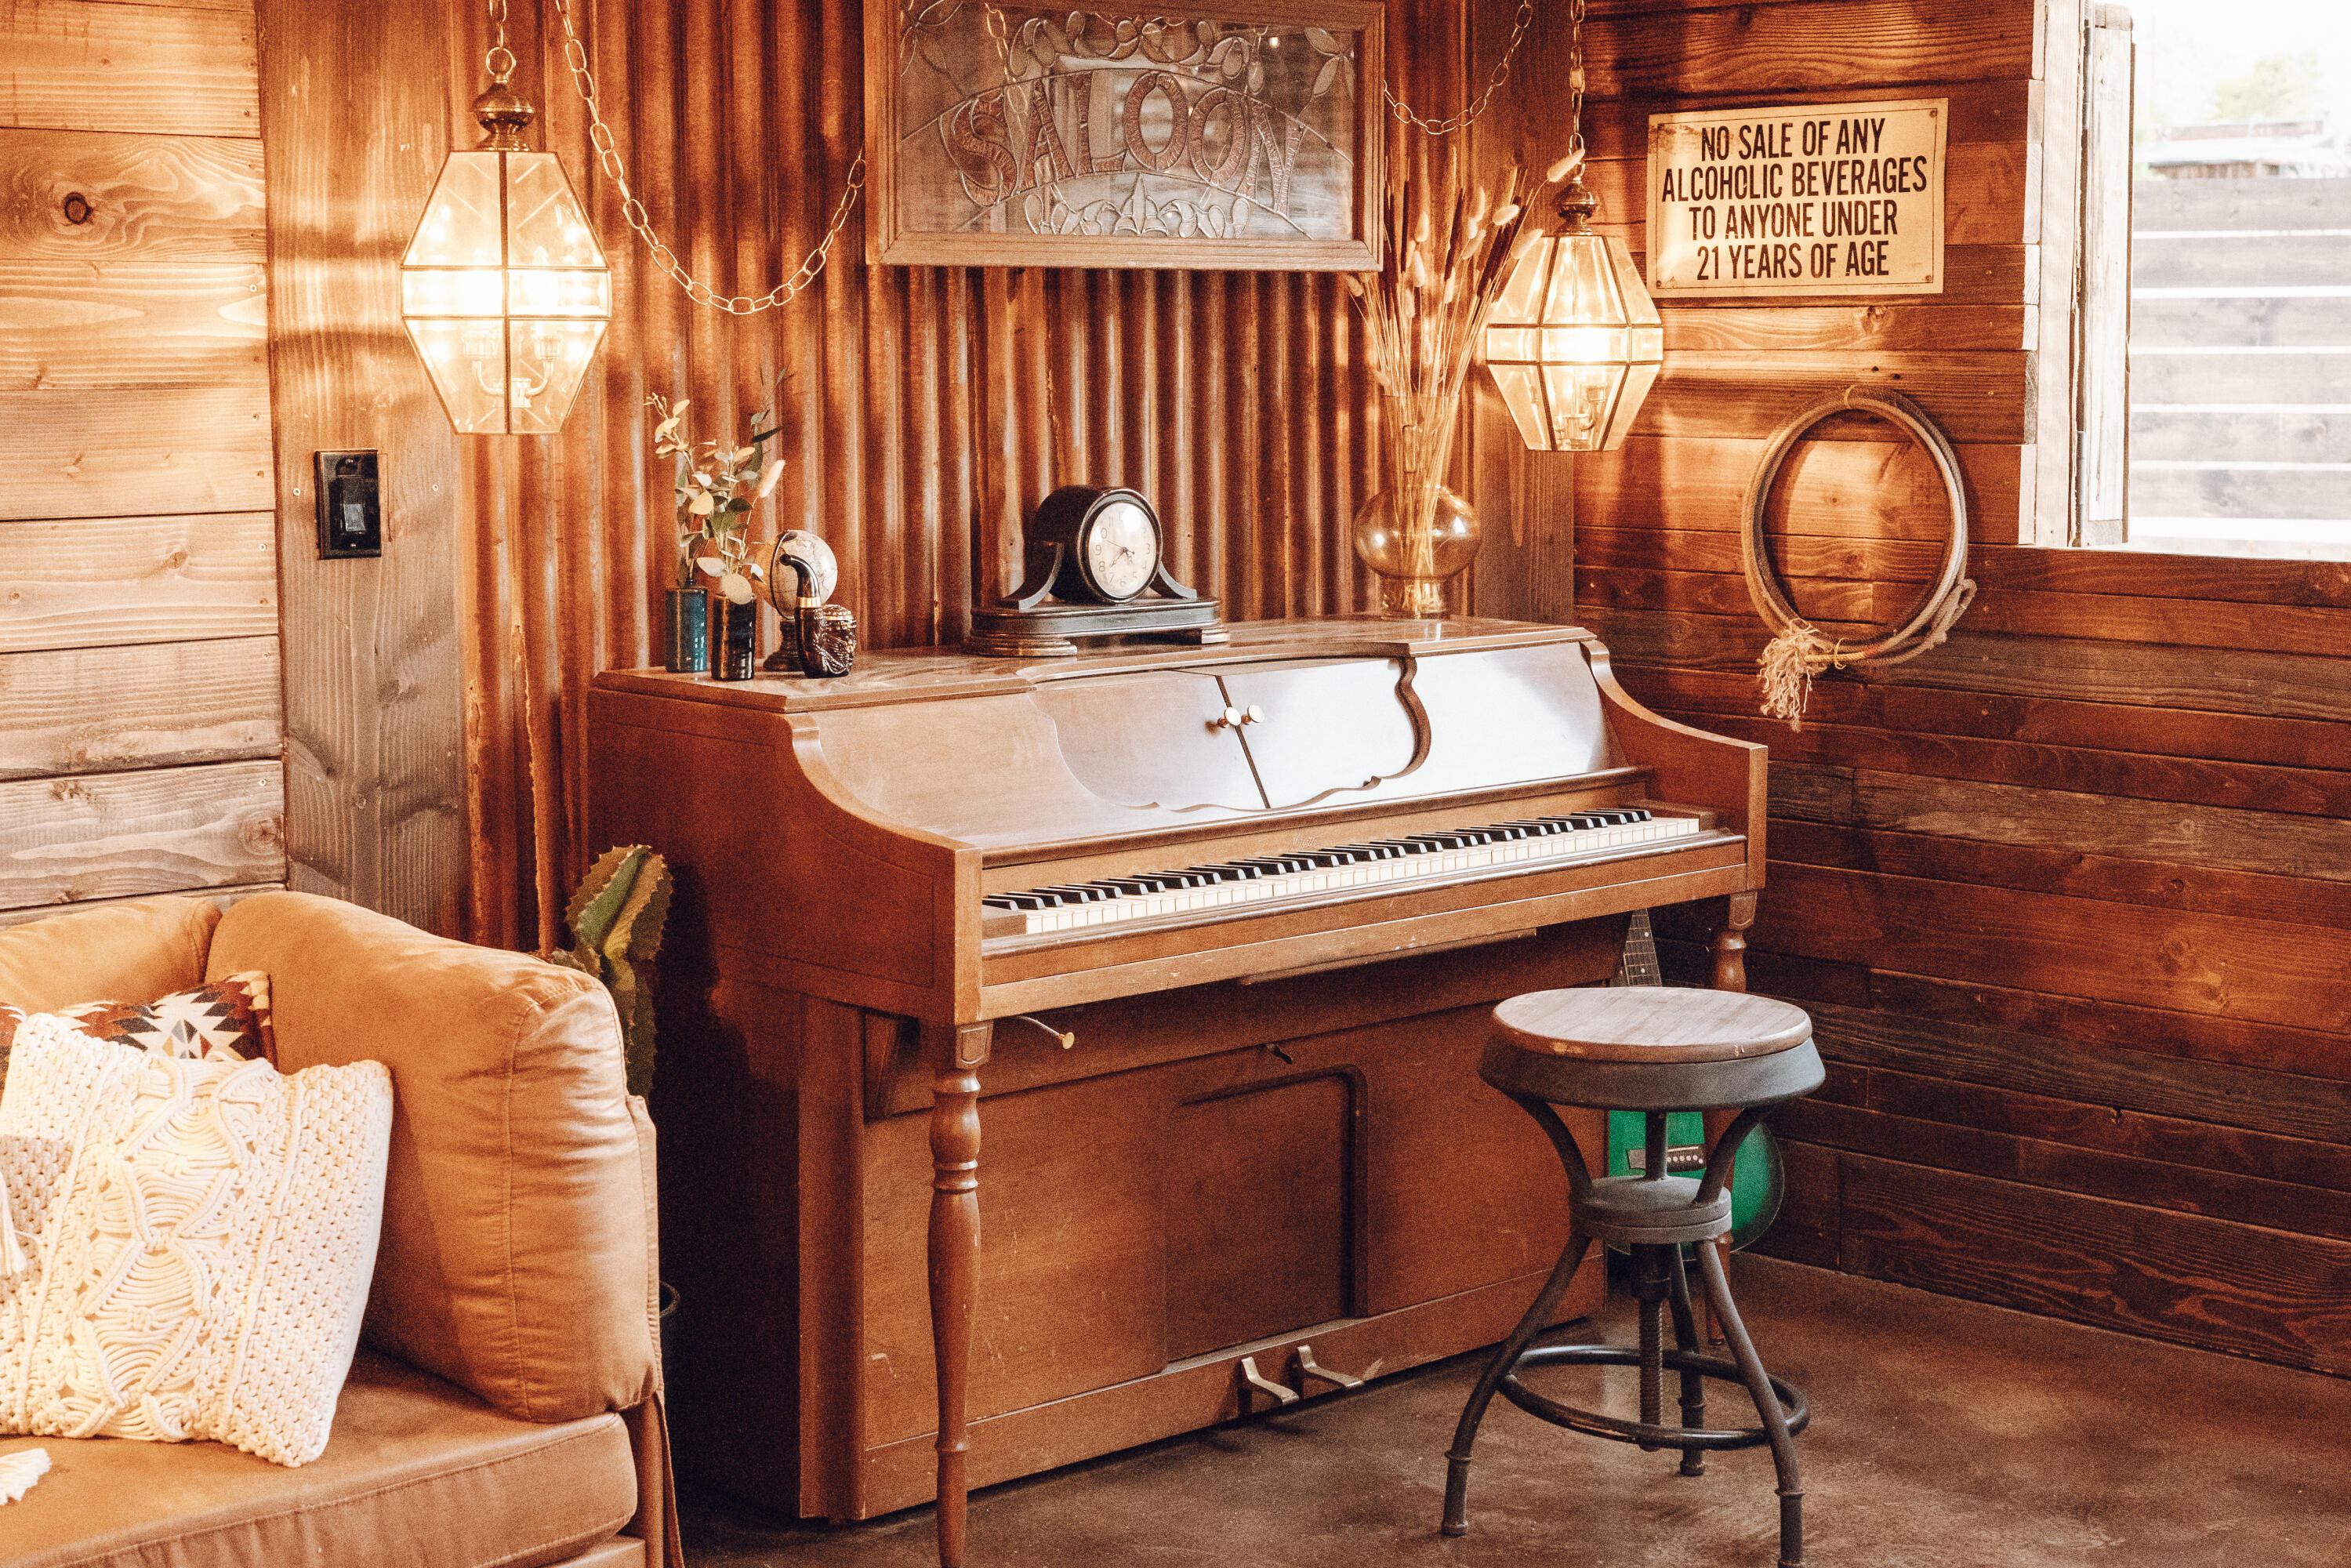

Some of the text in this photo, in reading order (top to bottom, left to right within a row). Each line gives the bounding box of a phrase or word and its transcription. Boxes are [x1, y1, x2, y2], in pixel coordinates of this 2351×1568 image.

[951, 71, 1304, 214] SALOON
[1701, 118, 1885, 162] NO SALE OF ANY
[1662, 155, 1927, 202] ALCOHOLIC BEVERAGES
[1689, 200, 1897, 241] TO ANYONE UNDER
[1697, 241, 1889, 280] 21 YEARS OF AGE
[1095, 544, 1102, 556] 9
[1098, 561, 1106, 572] 8
[1147, 543, 1152, 554] 3
[1109, 572, 1115, 584] 7
